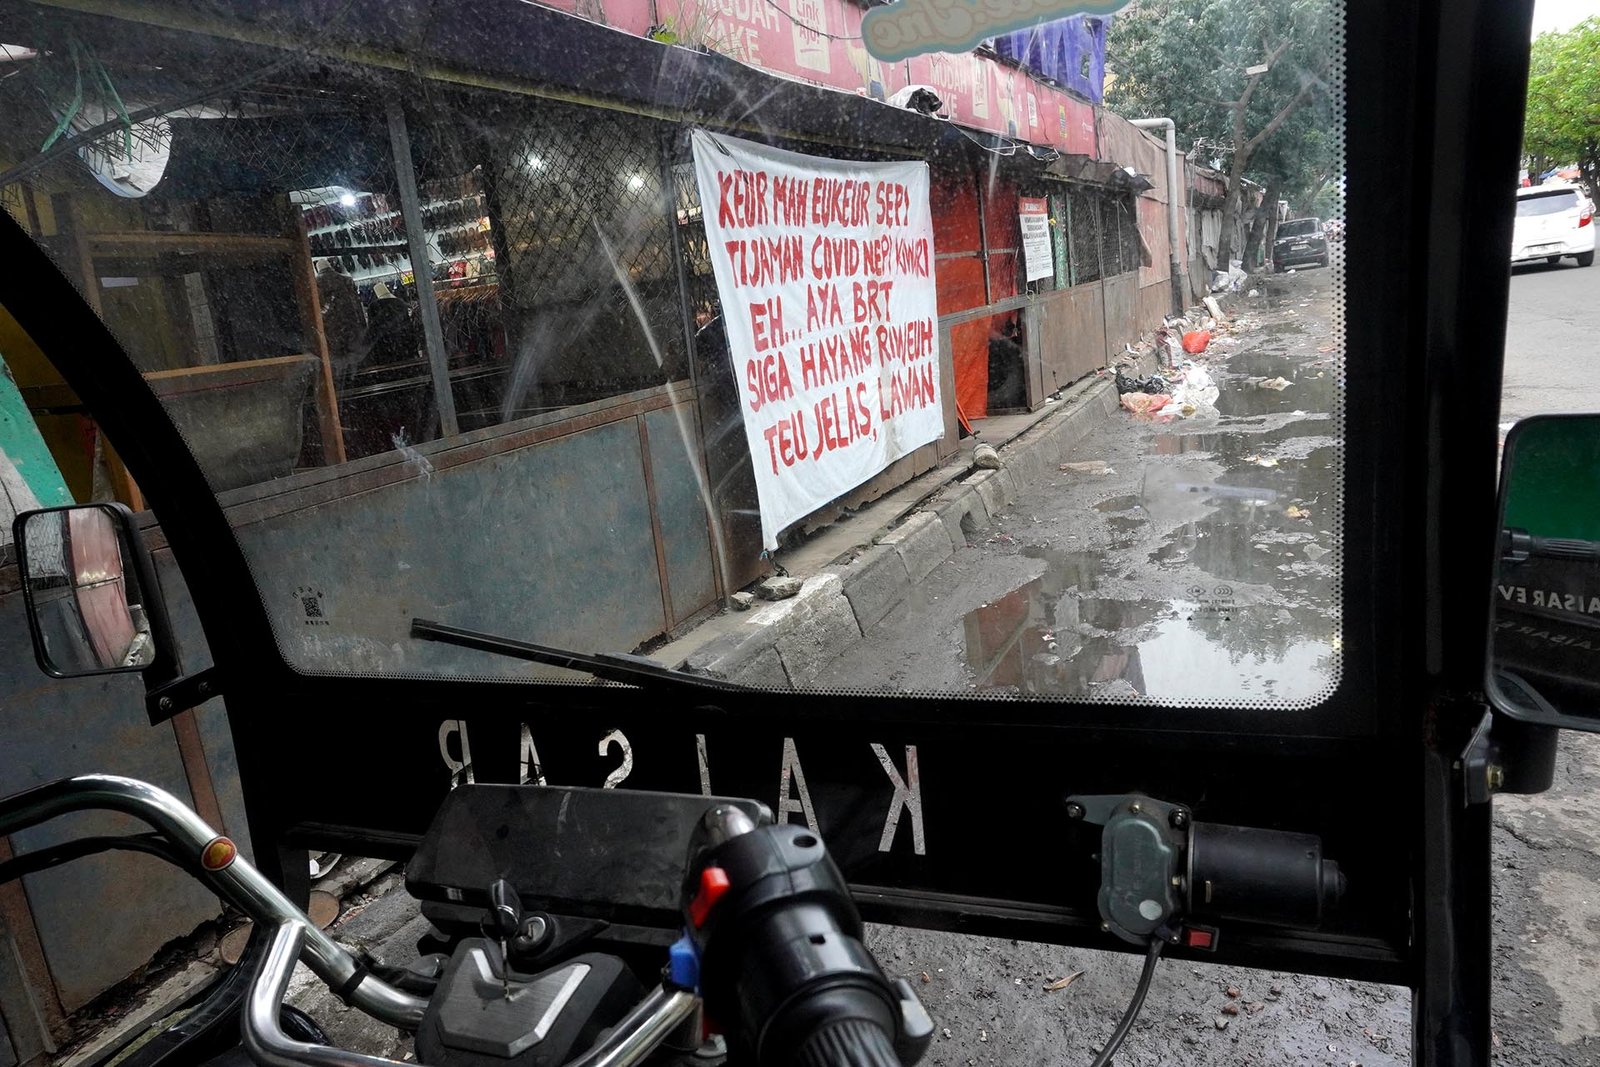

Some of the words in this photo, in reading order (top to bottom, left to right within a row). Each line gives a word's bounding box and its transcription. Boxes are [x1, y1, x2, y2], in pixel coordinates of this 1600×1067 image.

[717, 169, 769, 229] KEUR
[773, 174, 808, 228] MAH
[812, 177, 870, 228] EUKEUR
[875, 180, 910, 229] SEPI
[725, 234, 804, 288] TIJAMAN
[811, 234, 860, 280] COVID
[863, 234, 891, 276] NEPI
[807, 282, 843, 332] AYA
[853, 280, 893, 324] BRT
[747, 351, 794, 412] SIGA
[800, 325, 872, 391] HAYANG
[876, 317, 933, 367] RIWEUH
[764, 410, 808, 476] TEU
[813, 382, 878, 461] JELAS,
[878, 362, 934, 422] LAWAN
